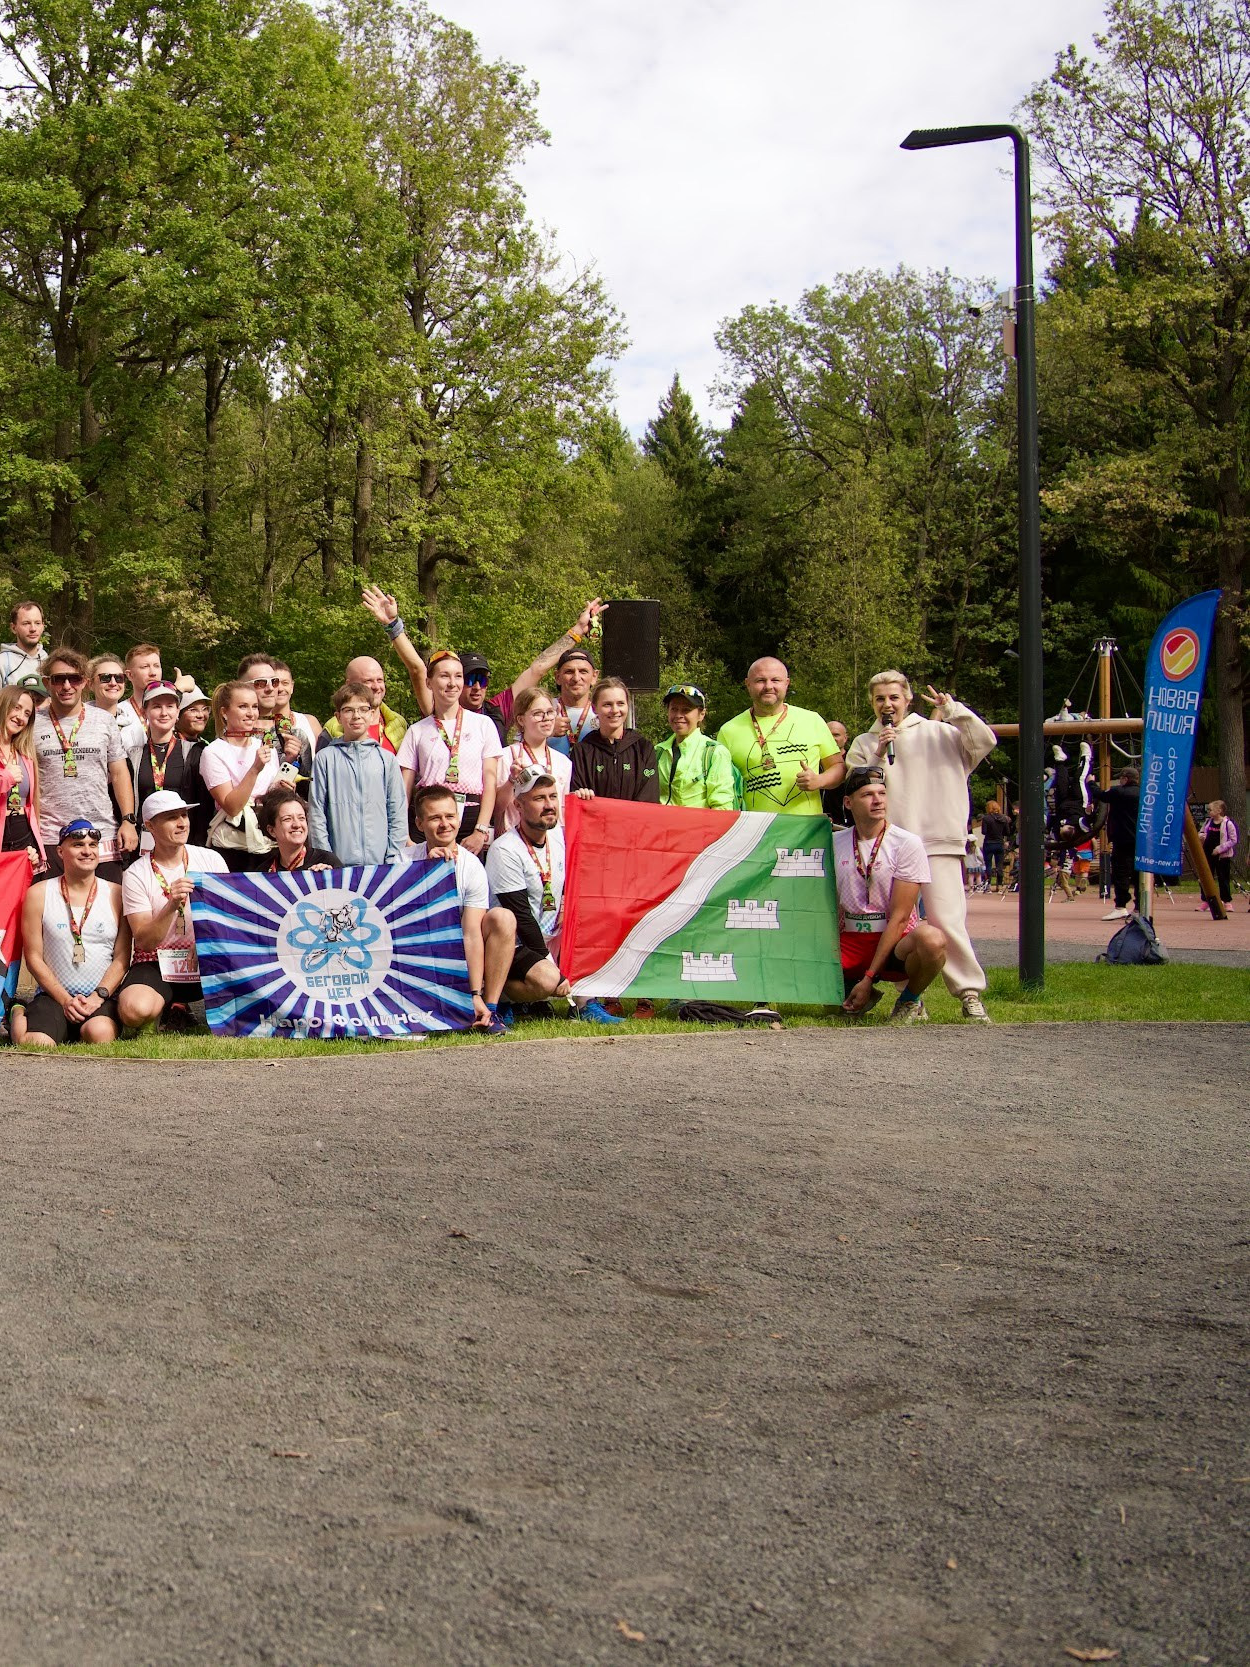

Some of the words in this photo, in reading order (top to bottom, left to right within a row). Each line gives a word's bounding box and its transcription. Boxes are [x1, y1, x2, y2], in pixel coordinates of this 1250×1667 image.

[305, 971, 370, 988] БЕГОВОЙ
[327, 987, 353, 1001] ЦЕХ
[259, 1010, 437, 1030] Наро-Фоминск
